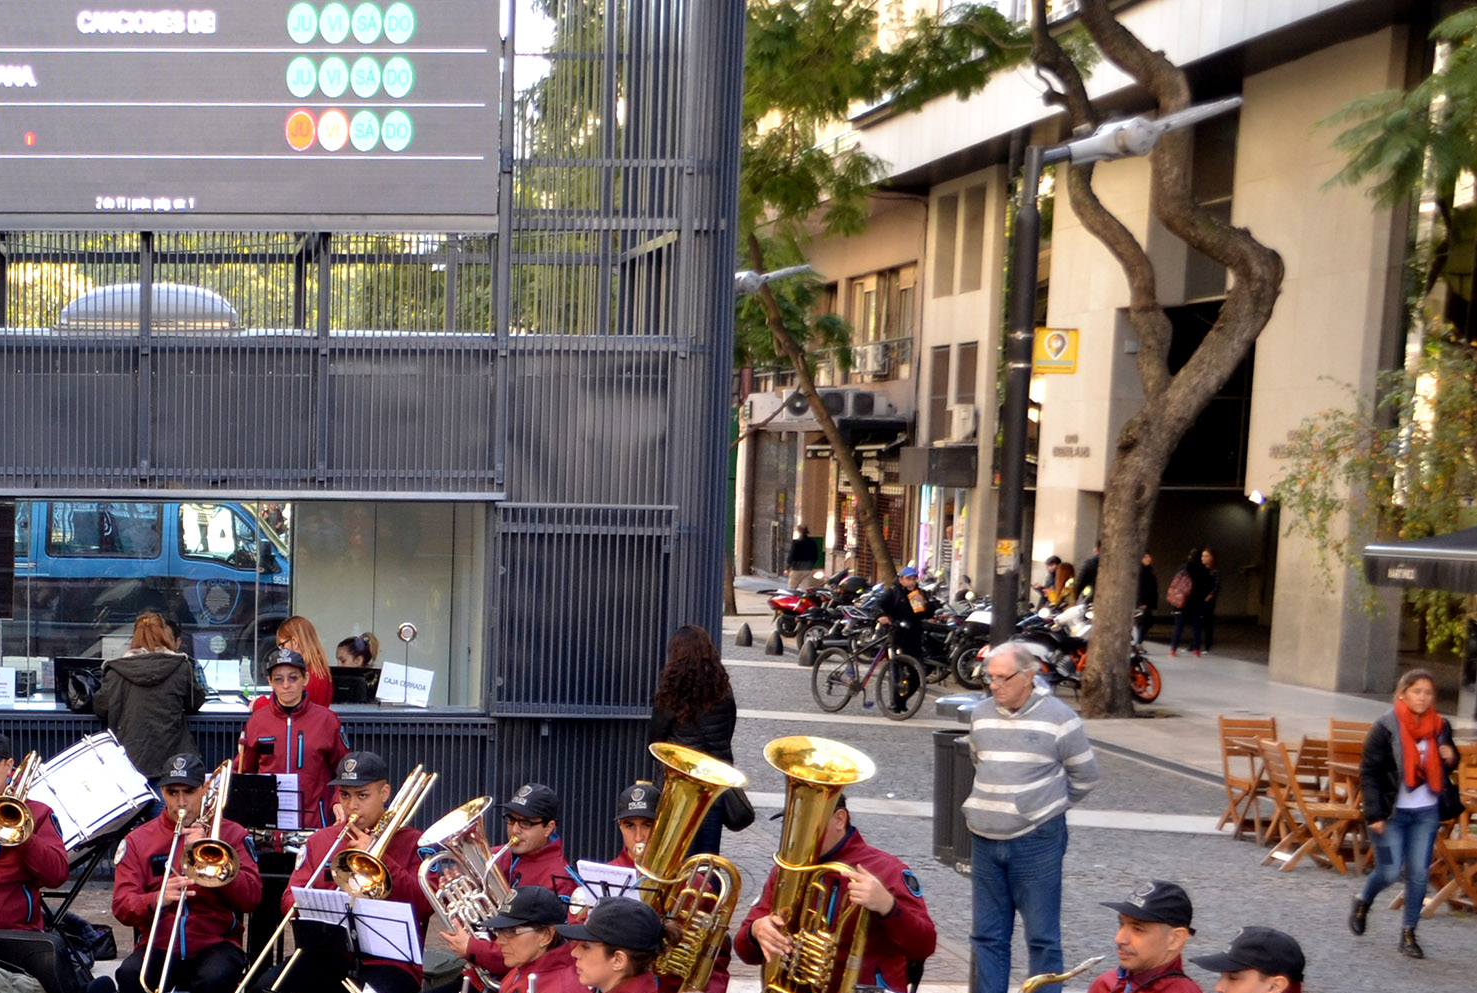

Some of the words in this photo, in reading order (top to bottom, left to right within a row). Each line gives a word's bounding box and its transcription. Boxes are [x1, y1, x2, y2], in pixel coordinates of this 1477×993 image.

[187, 10, 216, 33] DE
[292, 15, 312, 31] JU
[327, 15, 342, 32] VI
[388, 15, 411, 32] DO
[292, 69, 312, 86] JU
[326, 69, 341, 86] VI
[386, 69, 409, 86] DO
[291, 121, 311, 137] JU
[326, 122, 340, 138] VI
[385, 122, 409, 139] DO
[384, 677, 399, 686] CAJA
